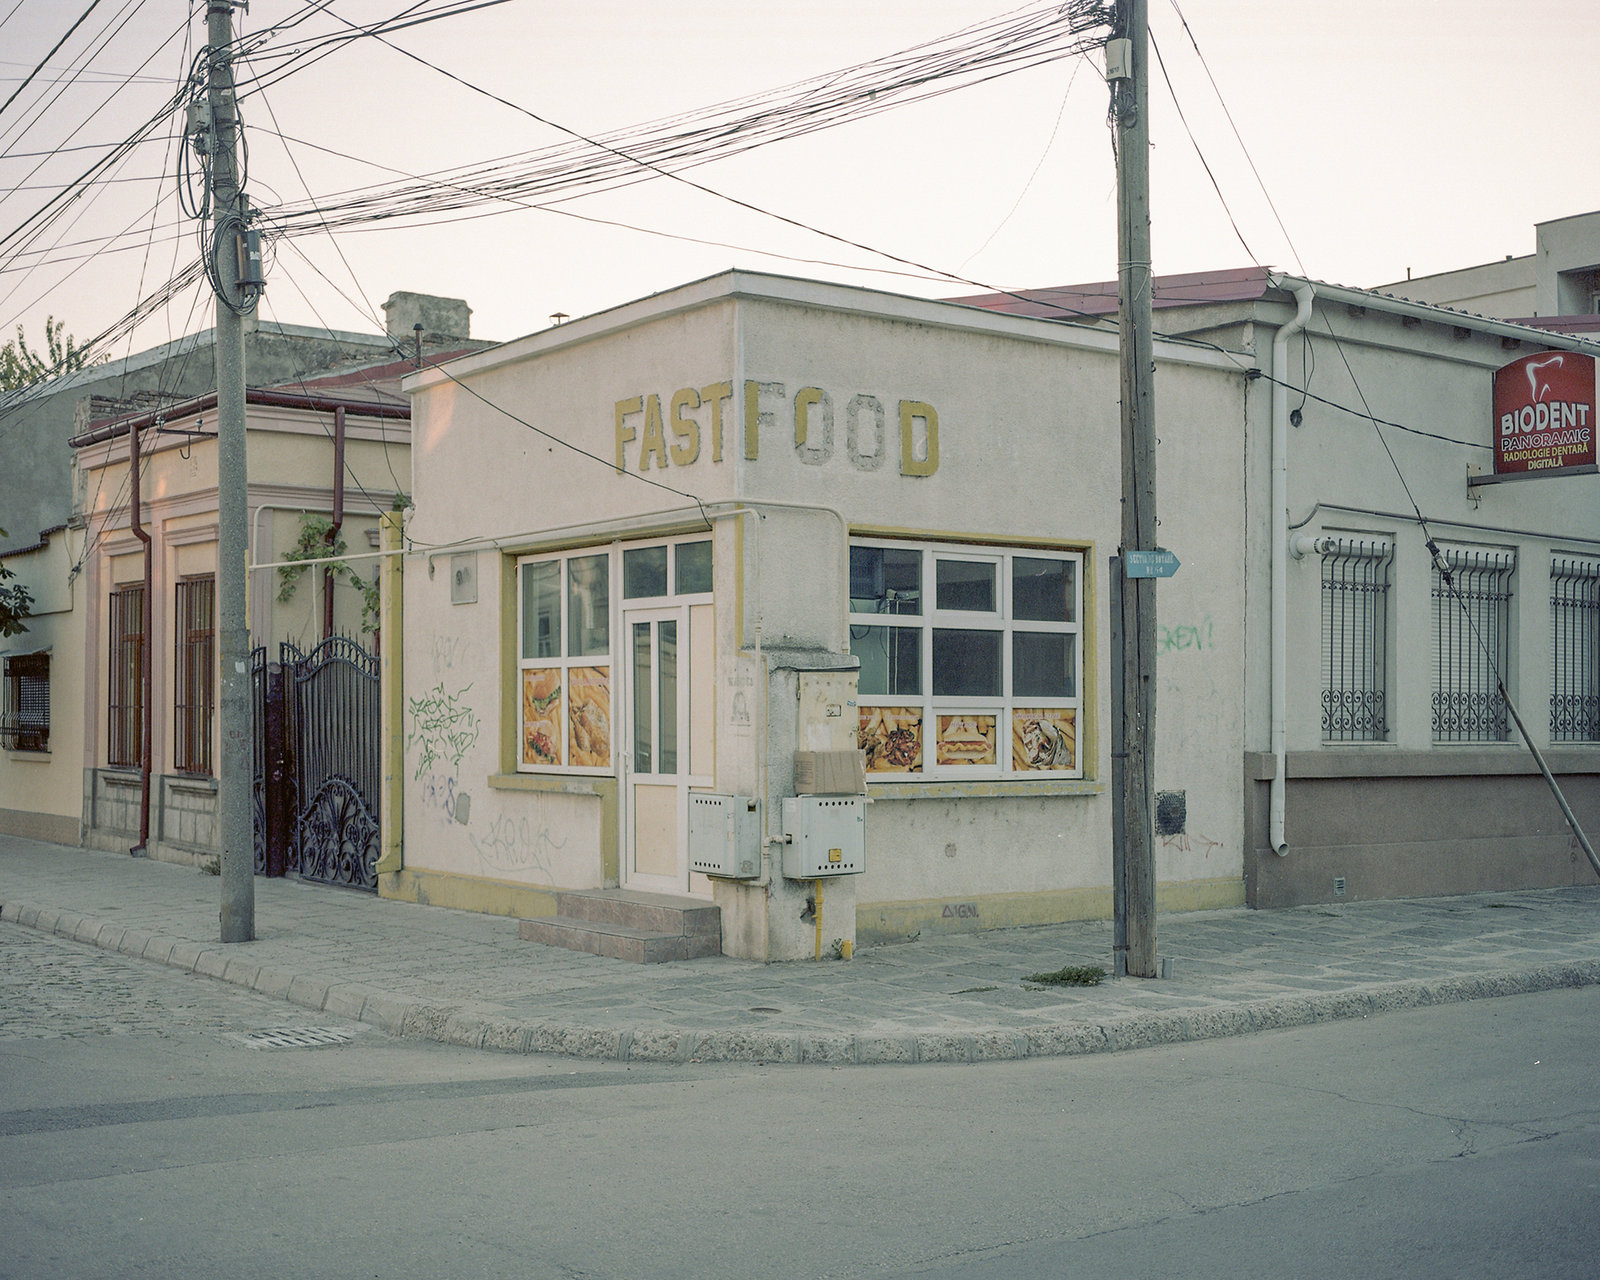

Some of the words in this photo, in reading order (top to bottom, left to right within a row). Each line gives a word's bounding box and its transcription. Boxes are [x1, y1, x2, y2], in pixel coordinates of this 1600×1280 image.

[614, 379, 734, 475] FAST
[743, 379, 939, 478] FOOD
[1501, 401, 1590, 436] BIODENT
[1501, 428, 1591, 452] PANORAMIC
[1503, 447, 1550, 462] RADIOLOGIE
[1551, 443, 1588, 456] DENTARĂ
[1527, 457, 1563, 470] DIGITALĂ
